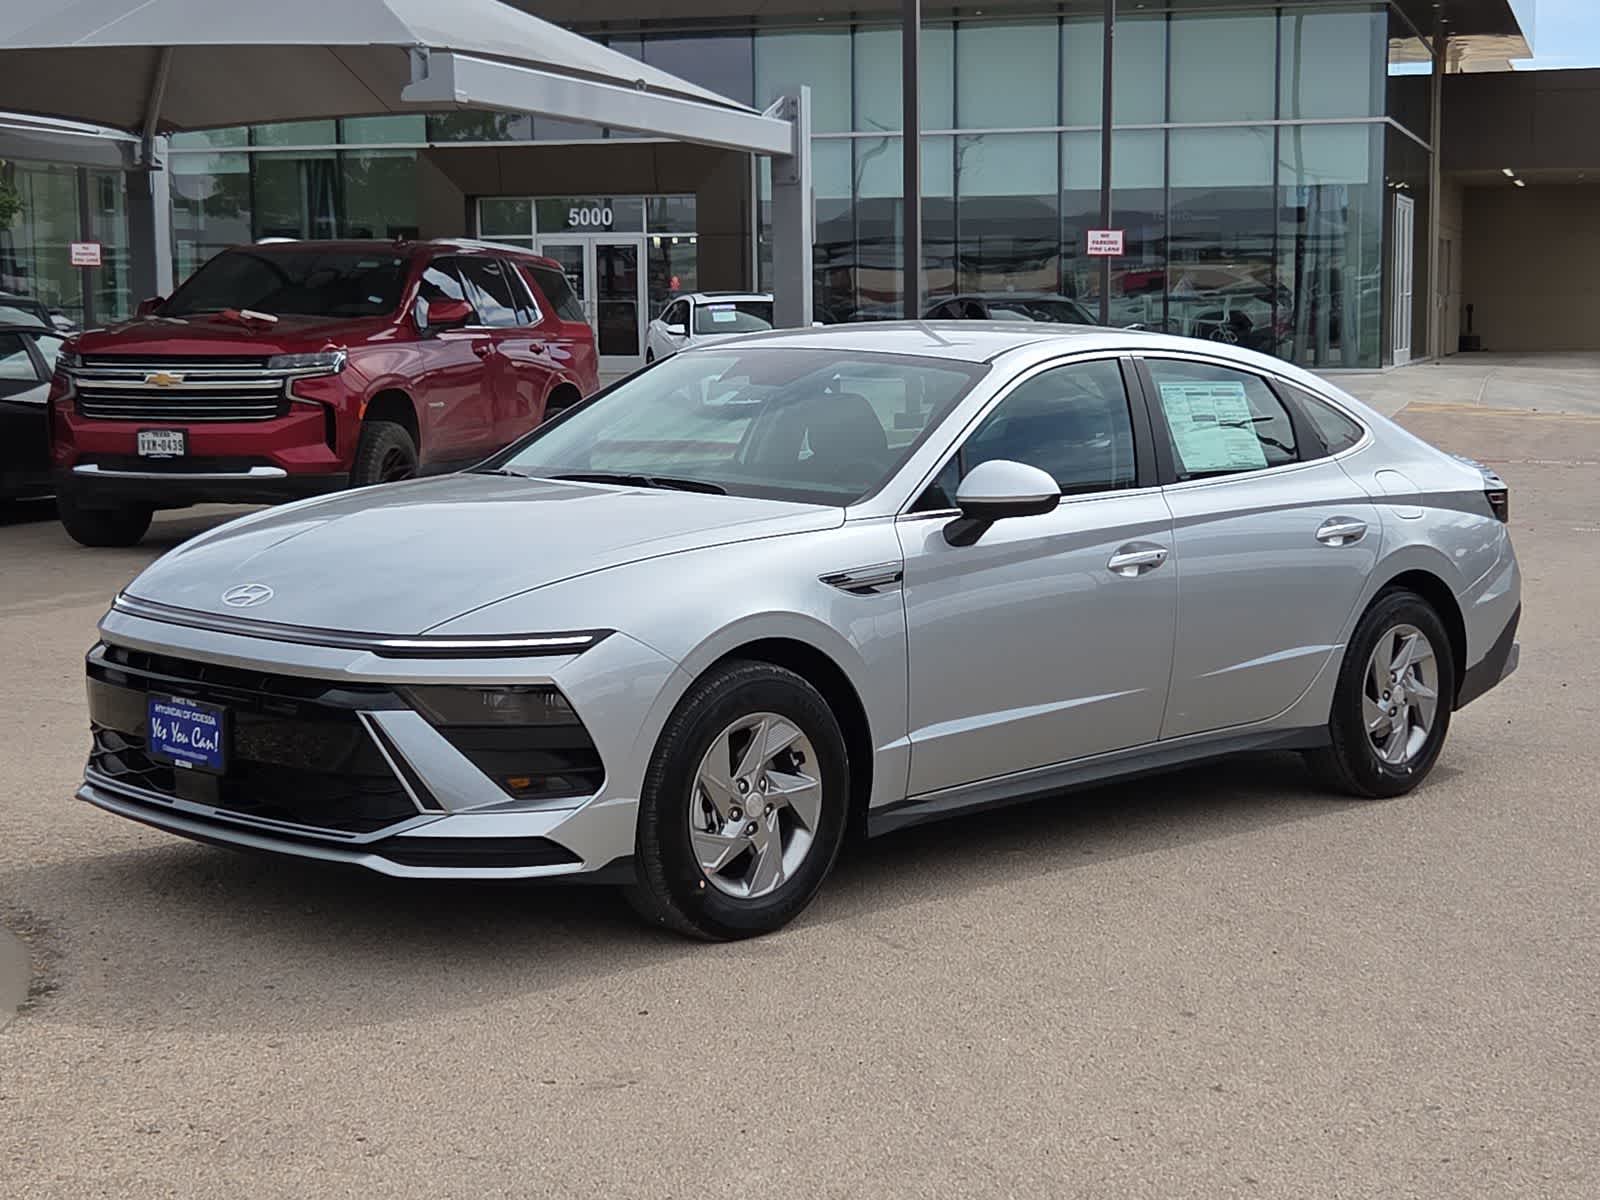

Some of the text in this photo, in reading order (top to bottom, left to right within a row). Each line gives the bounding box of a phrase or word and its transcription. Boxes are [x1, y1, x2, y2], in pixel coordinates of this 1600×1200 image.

[568, 207, 613, 226] 5000
[183, 710, 191, 719] OF
[152, 717, 168, 740] Yes
[171, 721, 189, 744] You
[192, 727, 219, 752] Can!
